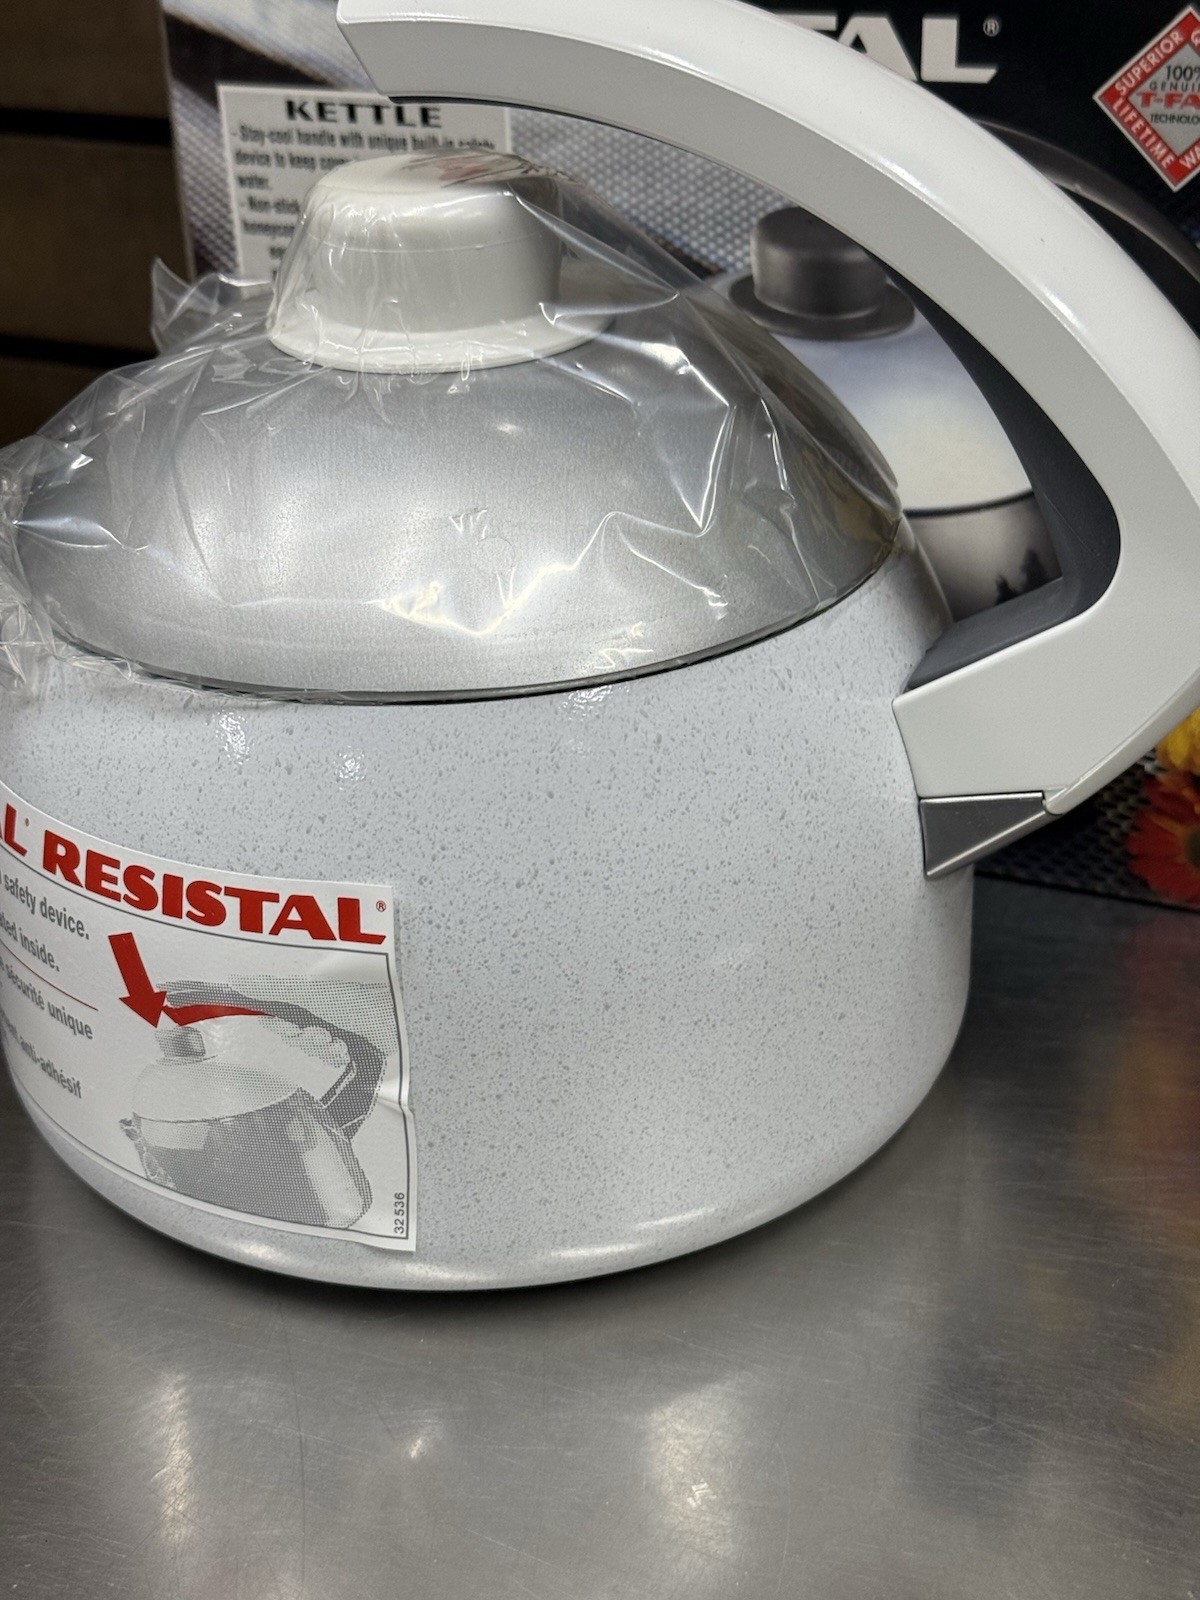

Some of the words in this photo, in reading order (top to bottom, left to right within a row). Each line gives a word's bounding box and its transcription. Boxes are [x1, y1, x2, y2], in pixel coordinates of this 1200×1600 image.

[1114, 29, 1184, 97] SUPERIOR
[239, 123, 292, 147] Stay-cool
[297, 129, 336, 148] handle
[340, 131, 364, 149] with
[367, 134, 408, 153] unique
[285, 100, 442, 128] KETTLE
[1112, 98, 1175, 169] LIFETIME
[235, 150, 272, 167] device
[275, 153, 286, 168] to
[289, 154, 317, 172] keep
[4, 874, 37, 916] safety
[40, 896, 90, 940] device.
[19, 926, 60, 973] inside.
[5, 963, 45, 1011] sécurité
[47, 1001, 93, 1041] unique
